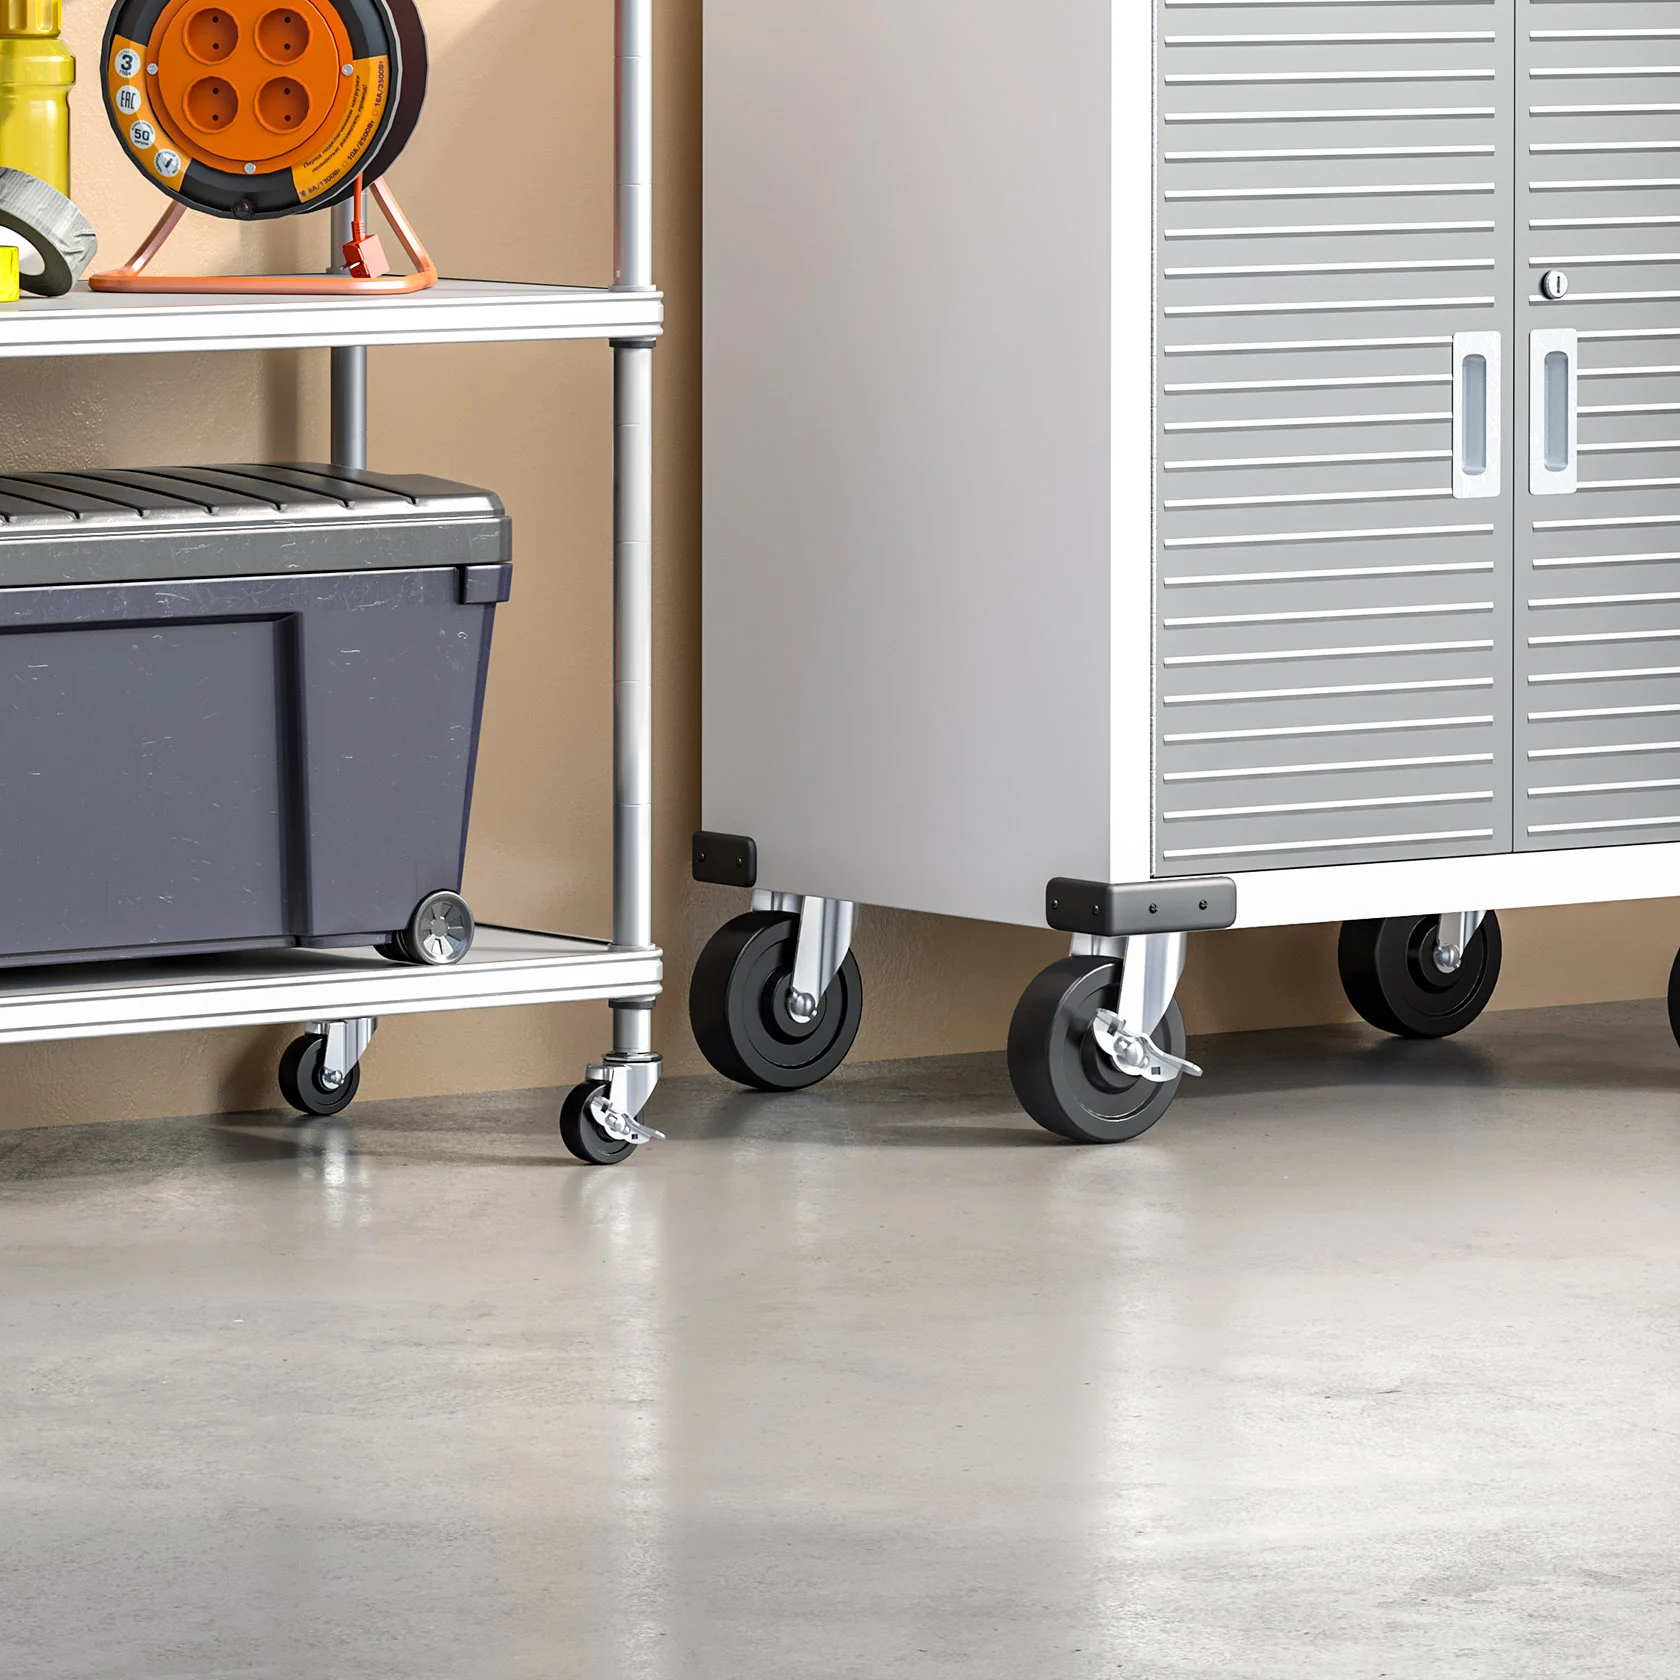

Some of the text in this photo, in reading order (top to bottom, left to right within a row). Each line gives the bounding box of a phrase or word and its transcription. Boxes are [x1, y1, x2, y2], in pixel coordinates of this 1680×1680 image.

[121, 54, 133, 71] 3
[121, 90, 136, 109] EAC
[134, 128, 150, 141] 50
